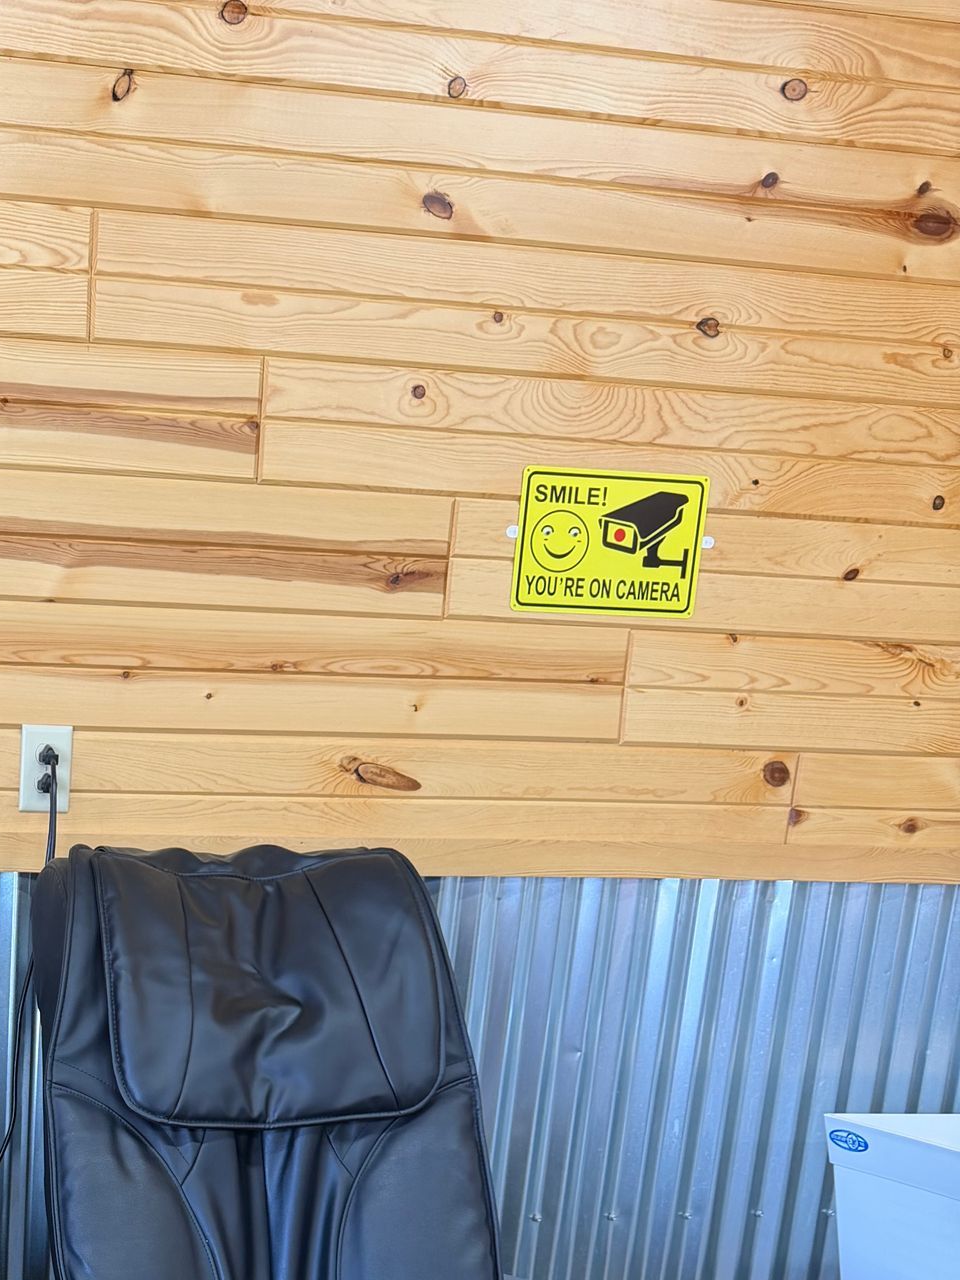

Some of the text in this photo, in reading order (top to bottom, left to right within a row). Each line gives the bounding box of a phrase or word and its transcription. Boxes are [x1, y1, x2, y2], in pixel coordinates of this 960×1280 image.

[535, 484, 608, 506] SMILE!
[525, 575, 680, 602] YOU'RE ON CAMERA
